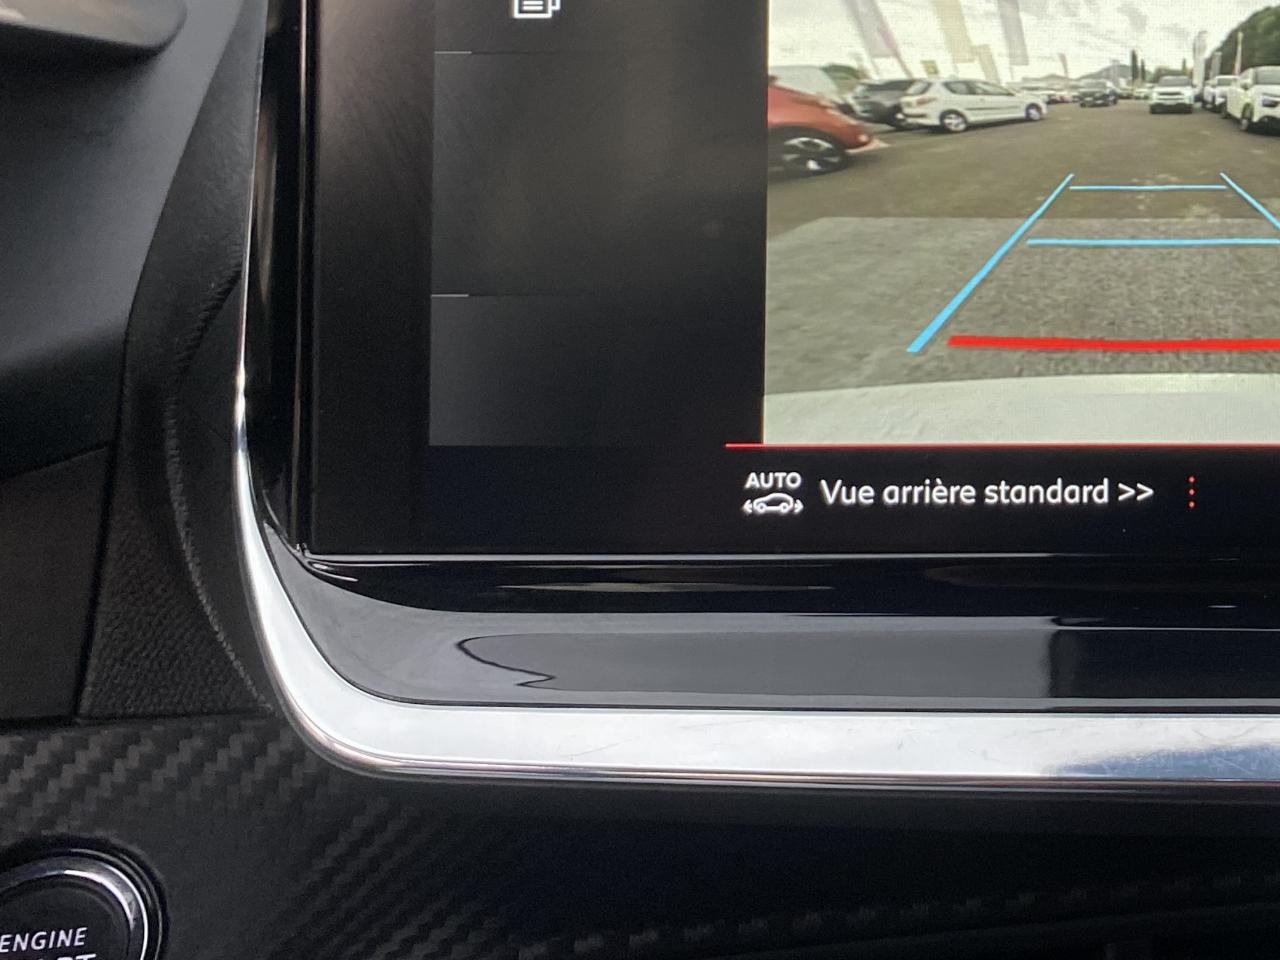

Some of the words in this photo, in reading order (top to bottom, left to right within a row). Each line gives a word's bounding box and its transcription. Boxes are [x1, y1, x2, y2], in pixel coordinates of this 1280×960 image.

[744, 472, 802, 490] AUTO
[819, 479, 875, 505] Vue
[882, 476, 977, 505] arrière
[984, 476, 1110, 505] standard
[0, 927, 88, 953] ENGINE
